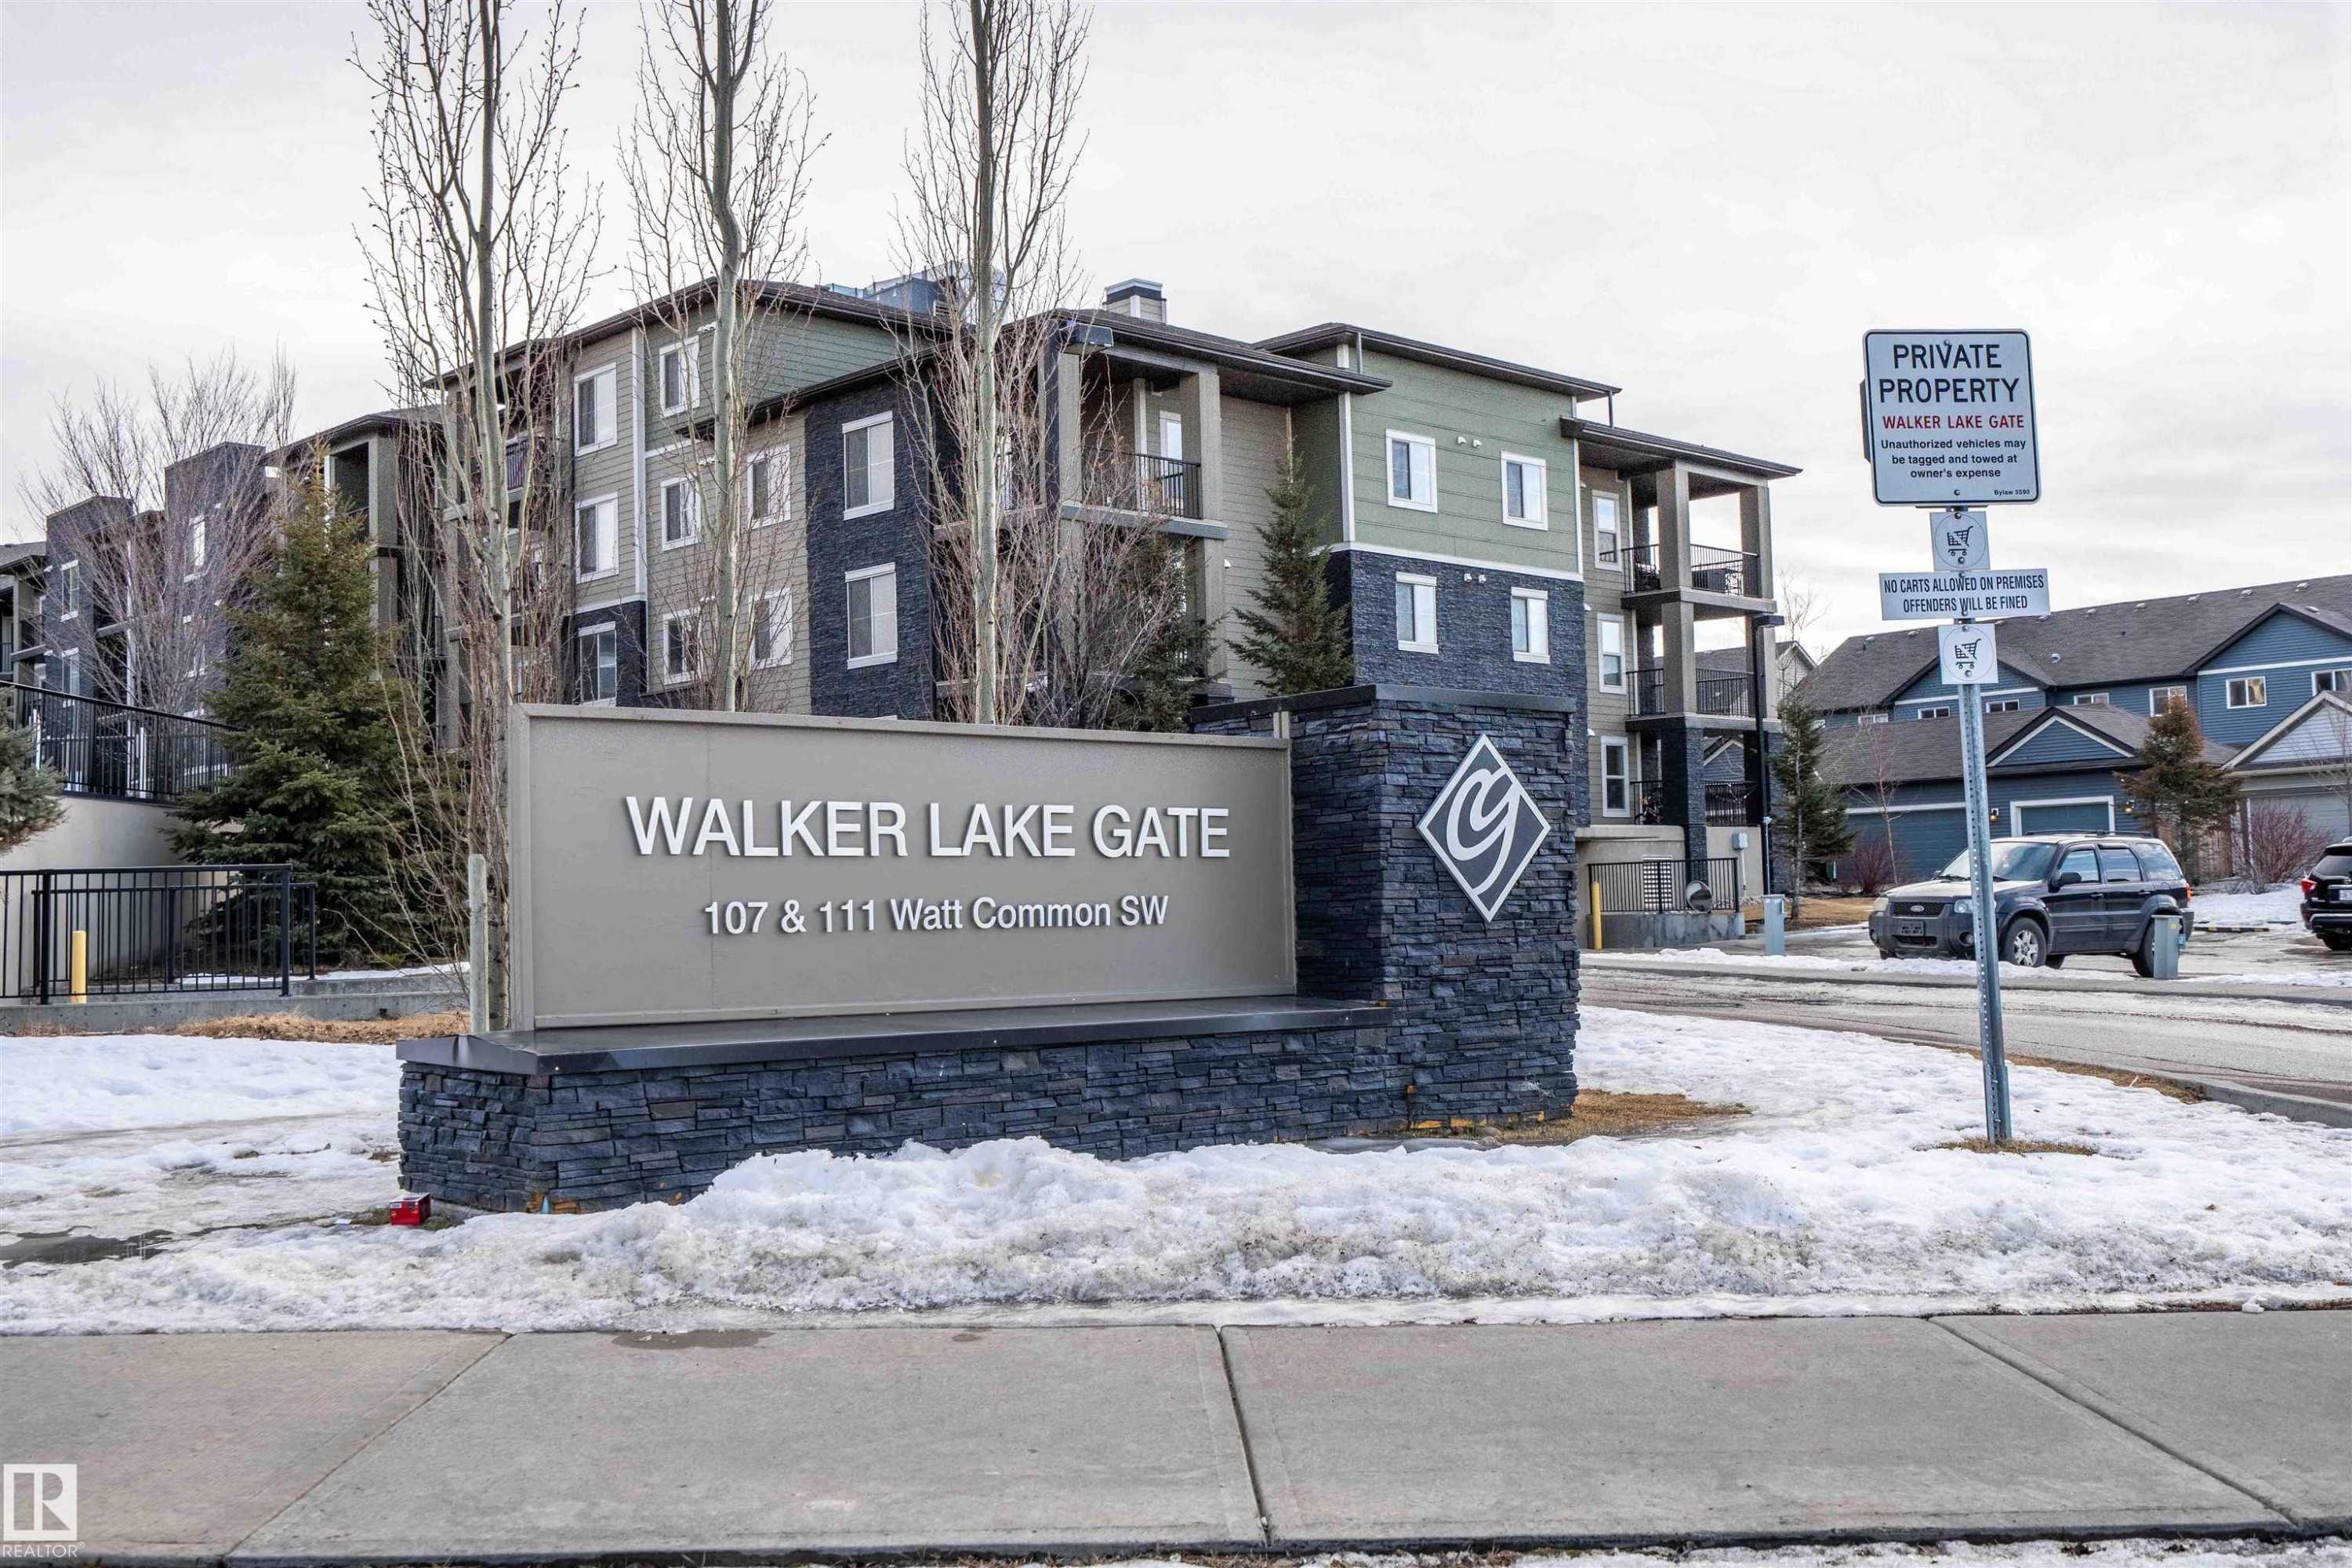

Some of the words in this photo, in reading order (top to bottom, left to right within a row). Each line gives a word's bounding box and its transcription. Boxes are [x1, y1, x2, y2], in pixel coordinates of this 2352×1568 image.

[1893, 344, 2002, 369] PRIVATE
[1879, 378, 2020, 403] PROPERTY
[1882, 416, 1941, 429] WALKER
[1947, 416, 1983, 428] LAKE
[1989, 415, 2024, 428] GATE
[1881, 440, 1953, 449] Unauthorized
[1956, 439, 2001, 448] vehicles
[2004, 439, 2026, 450] may
[1892, 456, 1905, 464] be
[1908, 456, 1945, 466] tagged
[1948, 455, 1969, 464] and
[1972, 455, 2004, 463] towed
[2007, 454, 2018, 463] at
[1910, 470, 1952, 478] owner's
[1955, 470, 2001, 479] expense
[1884, 580, 1897, 593] NO
[1900, 579, 1930, 593] CARTS
[1933, 575, 1977, 592] ALLOWED
[1980, 576, 1994, 590] ON
[1996, 575, 2045, 590] PREMISES
[1903, 598, 1958, 612] OFFENDERS
[1959, 597, 1984, 612] WILL
[1986, 597, 1998, 610] BE
[2000, 596, 2028, 609] FINED
[626, 797, 909, 857] WALKER
[930, 803, 1077, 858] LAKE
[1093, 805, 1230, 858] GATE
[704, 900, 770, 935] 107
[781, 900, 808, 933] &
[818, 899, 877, 932] 111
[891, 898, 964, 931] Watt
[972, 896, 1112, 930] Common
[1121, 895, 1169, 926] SW
